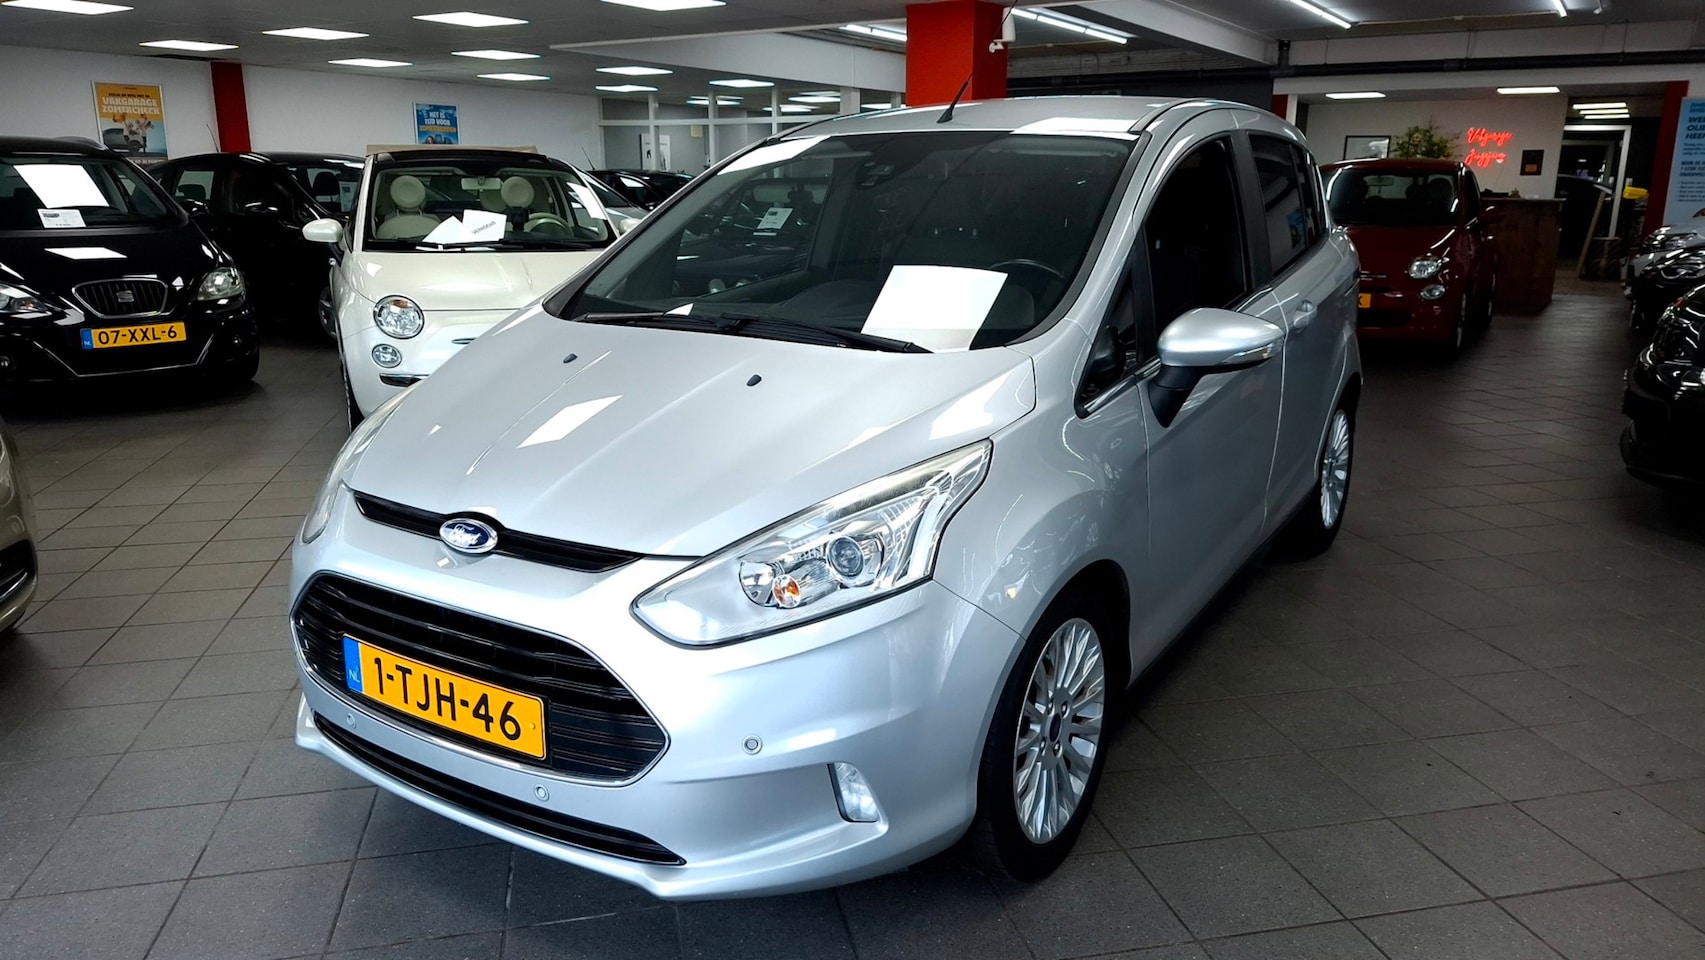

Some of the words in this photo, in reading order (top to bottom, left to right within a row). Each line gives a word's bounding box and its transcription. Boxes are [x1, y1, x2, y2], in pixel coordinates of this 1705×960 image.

[102, 97, 158, 106] VAKGARAGE
[102, 105, 160, 114] ZOMERCHECK
[98, 325, 177, 345] 07-XXL-6
[452, 523, 483, 548] Ford
[348, 668, 361, 684] NL
[374, 657, 521, 741] 1-TJH-46
